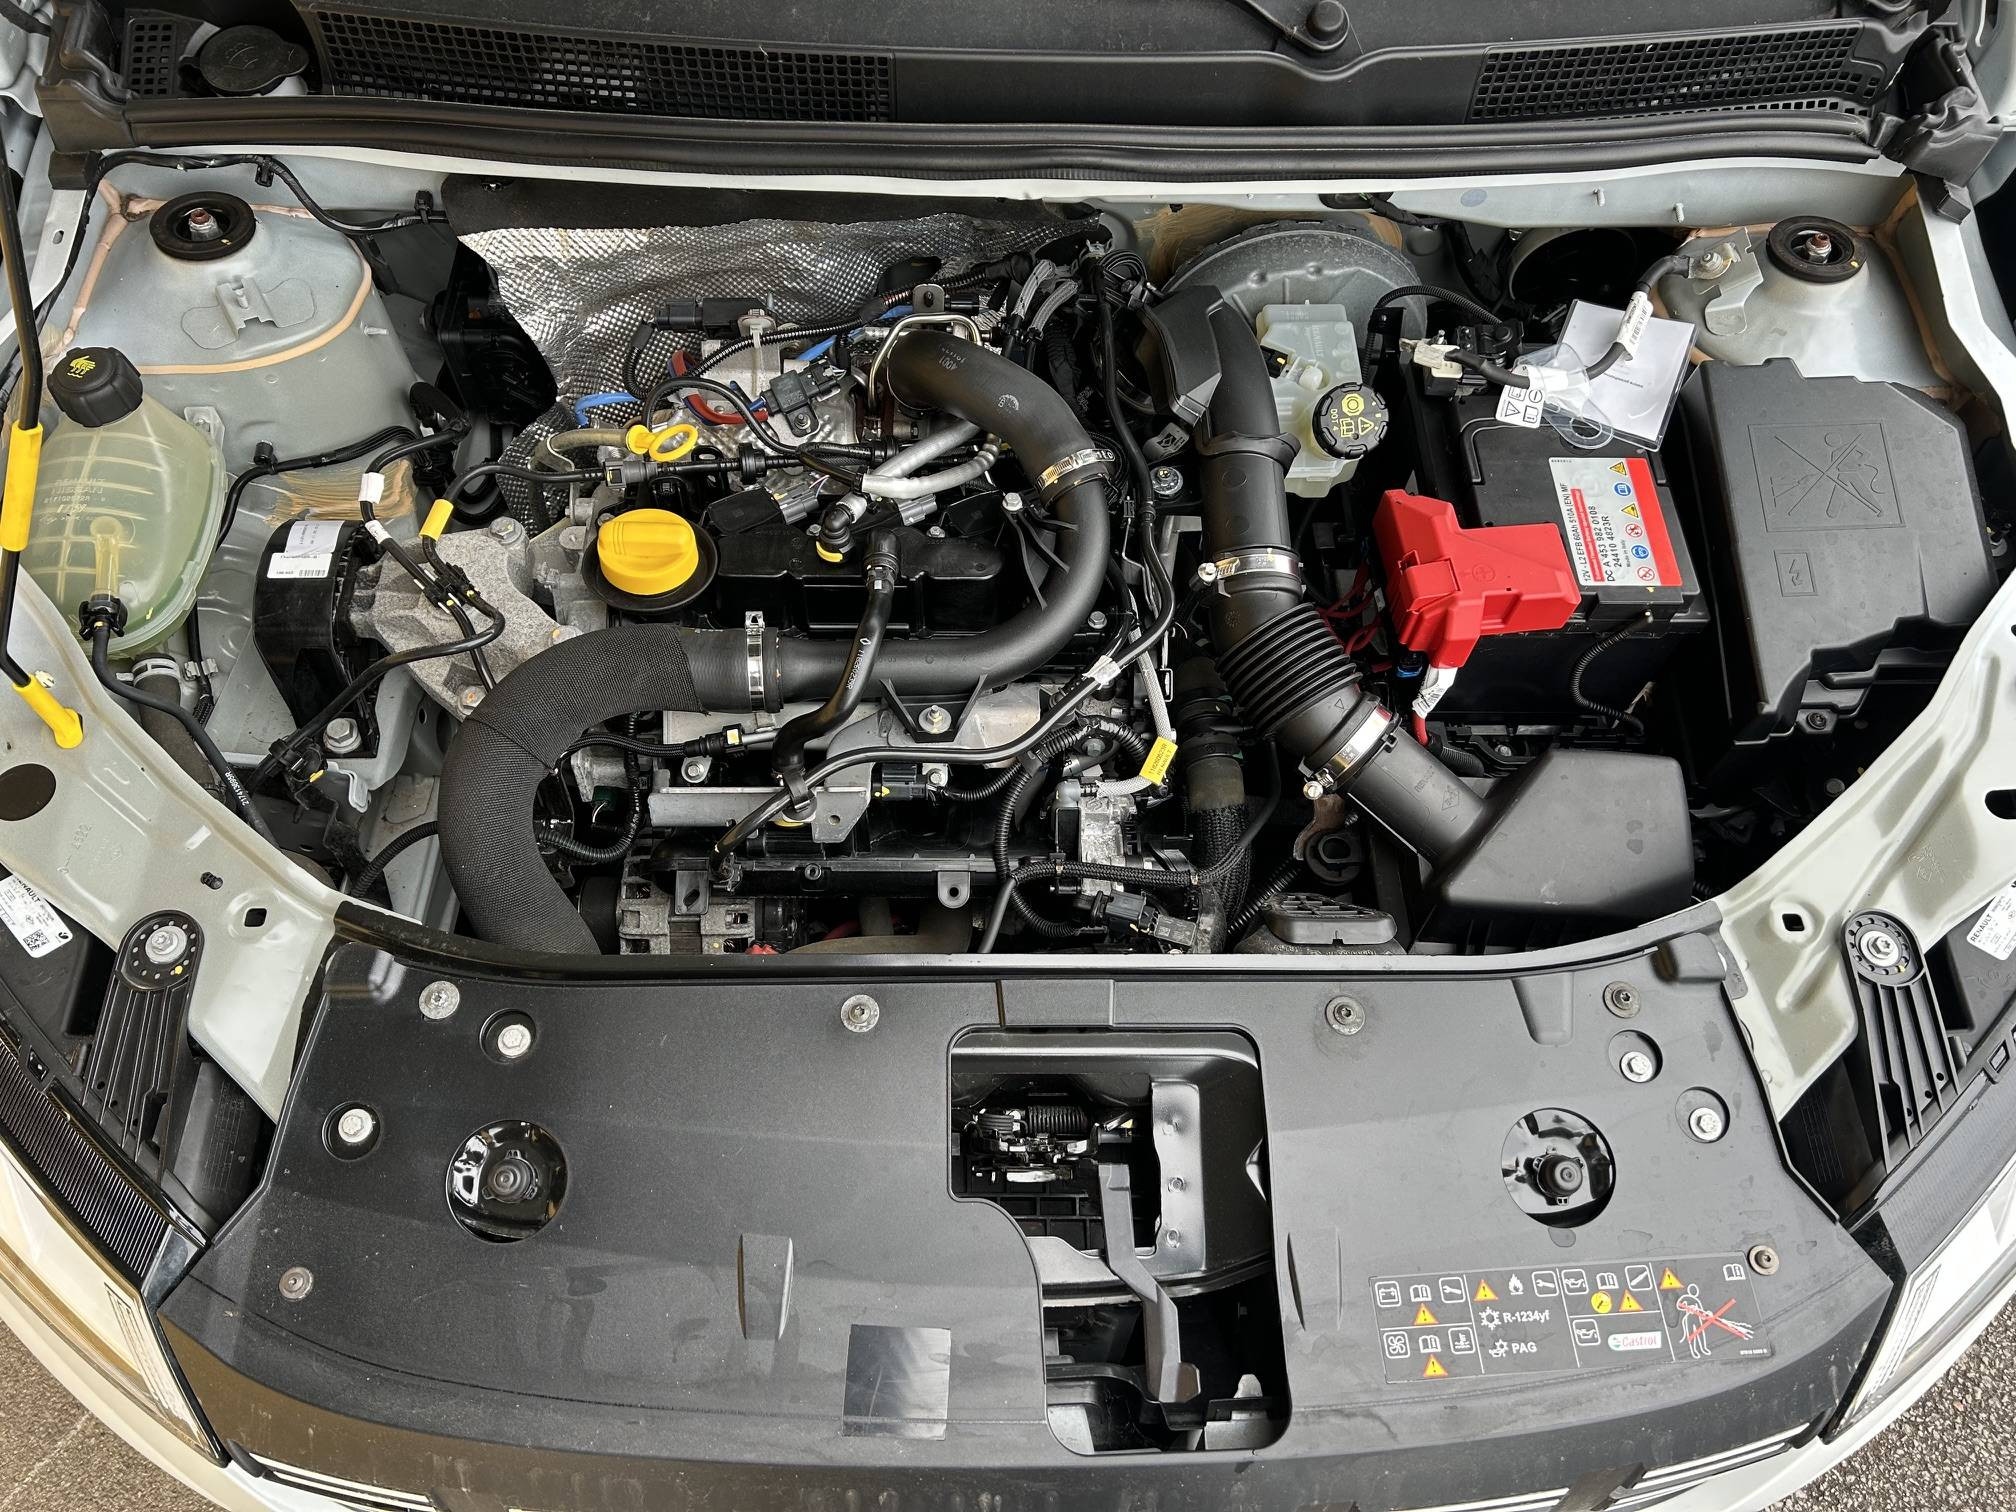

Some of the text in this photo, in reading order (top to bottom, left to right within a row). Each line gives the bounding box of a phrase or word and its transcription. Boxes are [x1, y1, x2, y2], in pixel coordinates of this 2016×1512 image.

[1330, 408, 1339, 424] DOT
[1560, 483, 1568, 493] MF
[1563, 493, 1572, 507] (EN)
[1567, 507, 1577, 524] 510A
[1588, 505, 1600, 524] 0108
[1571, 524, 1581, 541] 60Ah
[1594, 527, 1604, 542] 982
[1575, 541, 1585, 556] EFB
[1601, 515, 1622, 568] 24410 4823R
[1600, 544, 1609, 559] 453
[1579, 555, 1587, 565] L2
[1582, 568, 1591, 582] 12V
[1605, 570, 1616, 582] DC
[1970, 913, 1993, 942] RENAULT
[1502, 1309, 1550, 1325] R-1234yf
[1511, 1342, 1538, 1354] PAG
[1622, 1334, 1657, 1347] Castrol
